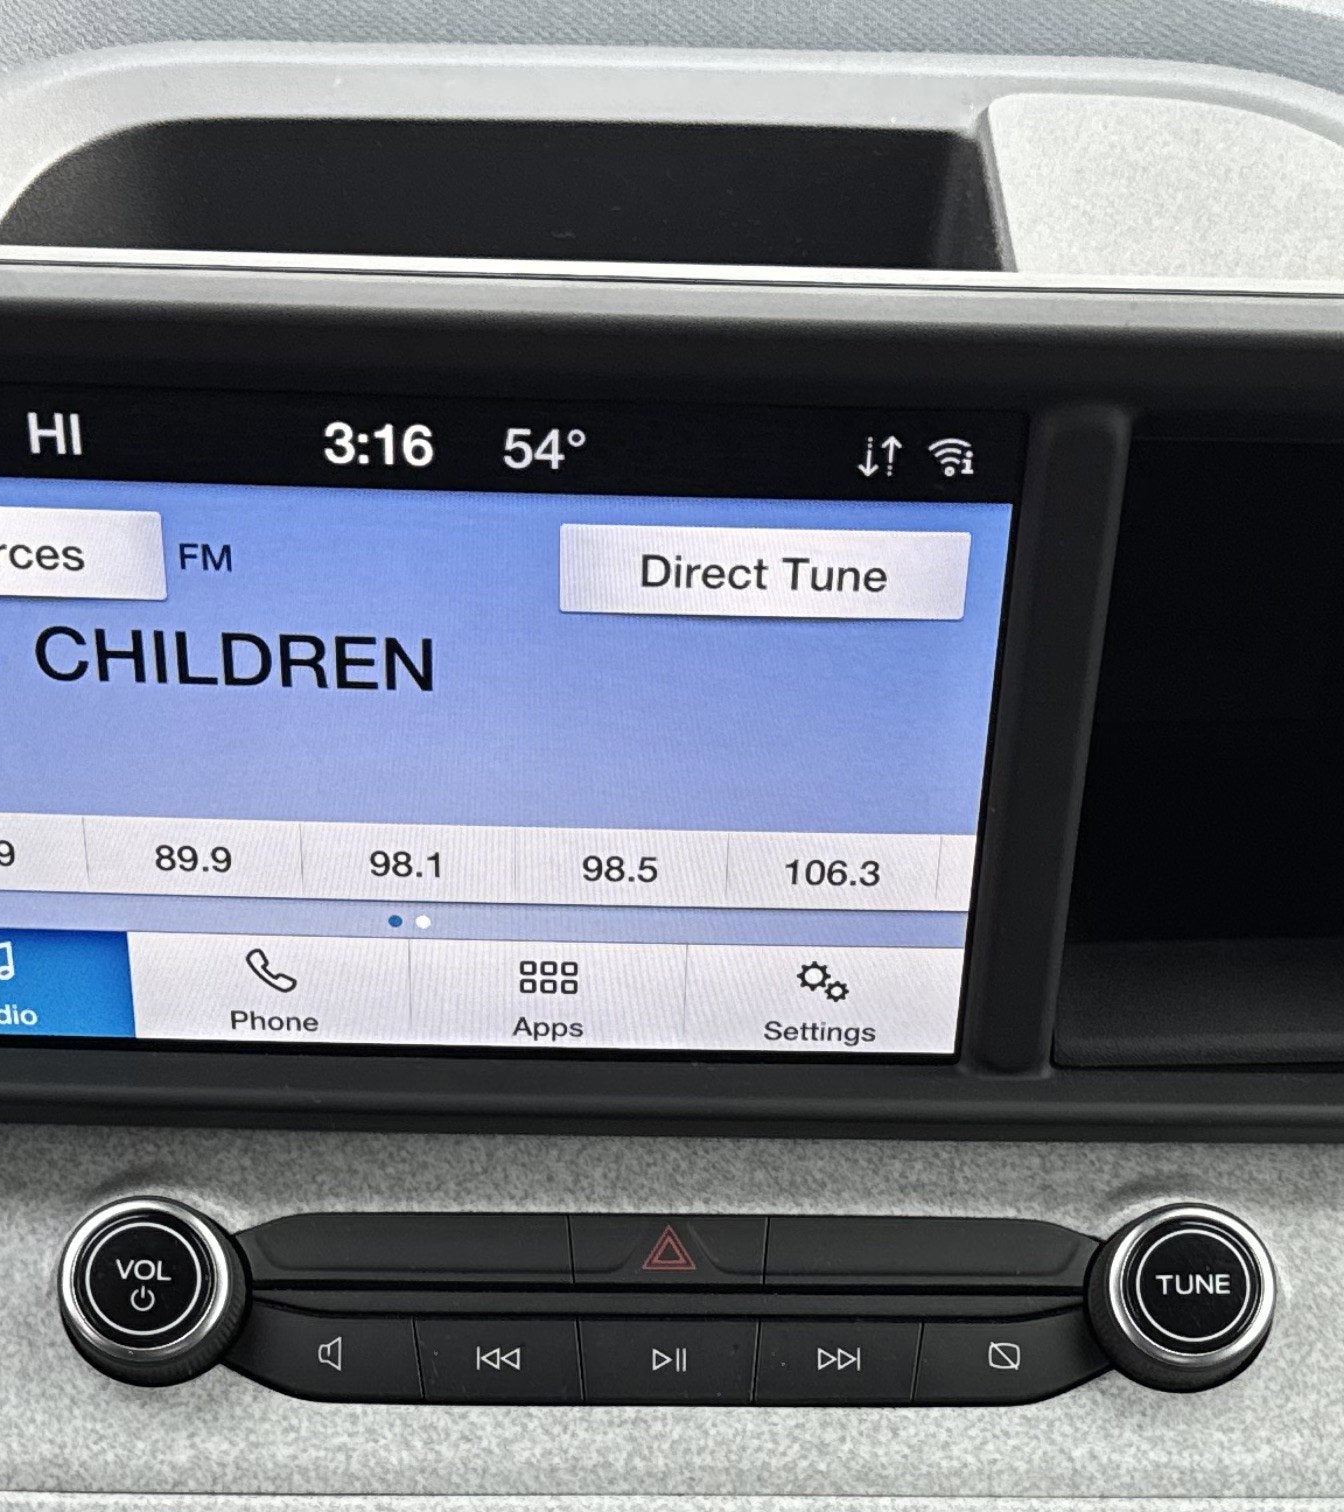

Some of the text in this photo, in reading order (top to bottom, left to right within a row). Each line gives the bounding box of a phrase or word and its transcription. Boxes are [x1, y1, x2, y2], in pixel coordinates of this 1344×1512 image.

[26, 412, 83, 456] HI
[323, 421, 433, 467] 3:16
[178, 543, 233, 573] FM
[640, 553, 888, 594] Direct Tune
[34, 626, 434, 691] CHILDREN
[155, 845, 233, 873] 89.9
[369, 850, 442, 879] 98.1
[582, 855, 658, 882] 98.5
[784, 859, 881, 887] 106.3
[230, 1010, 320, 1032] Phone
[512, 1016, 584, 1040] Apps
[763, 1021, 877, 1047] Settings
[116, 1259, 171, 1282] VOL
[1156, 1273, 1231, 1295] TUNE
